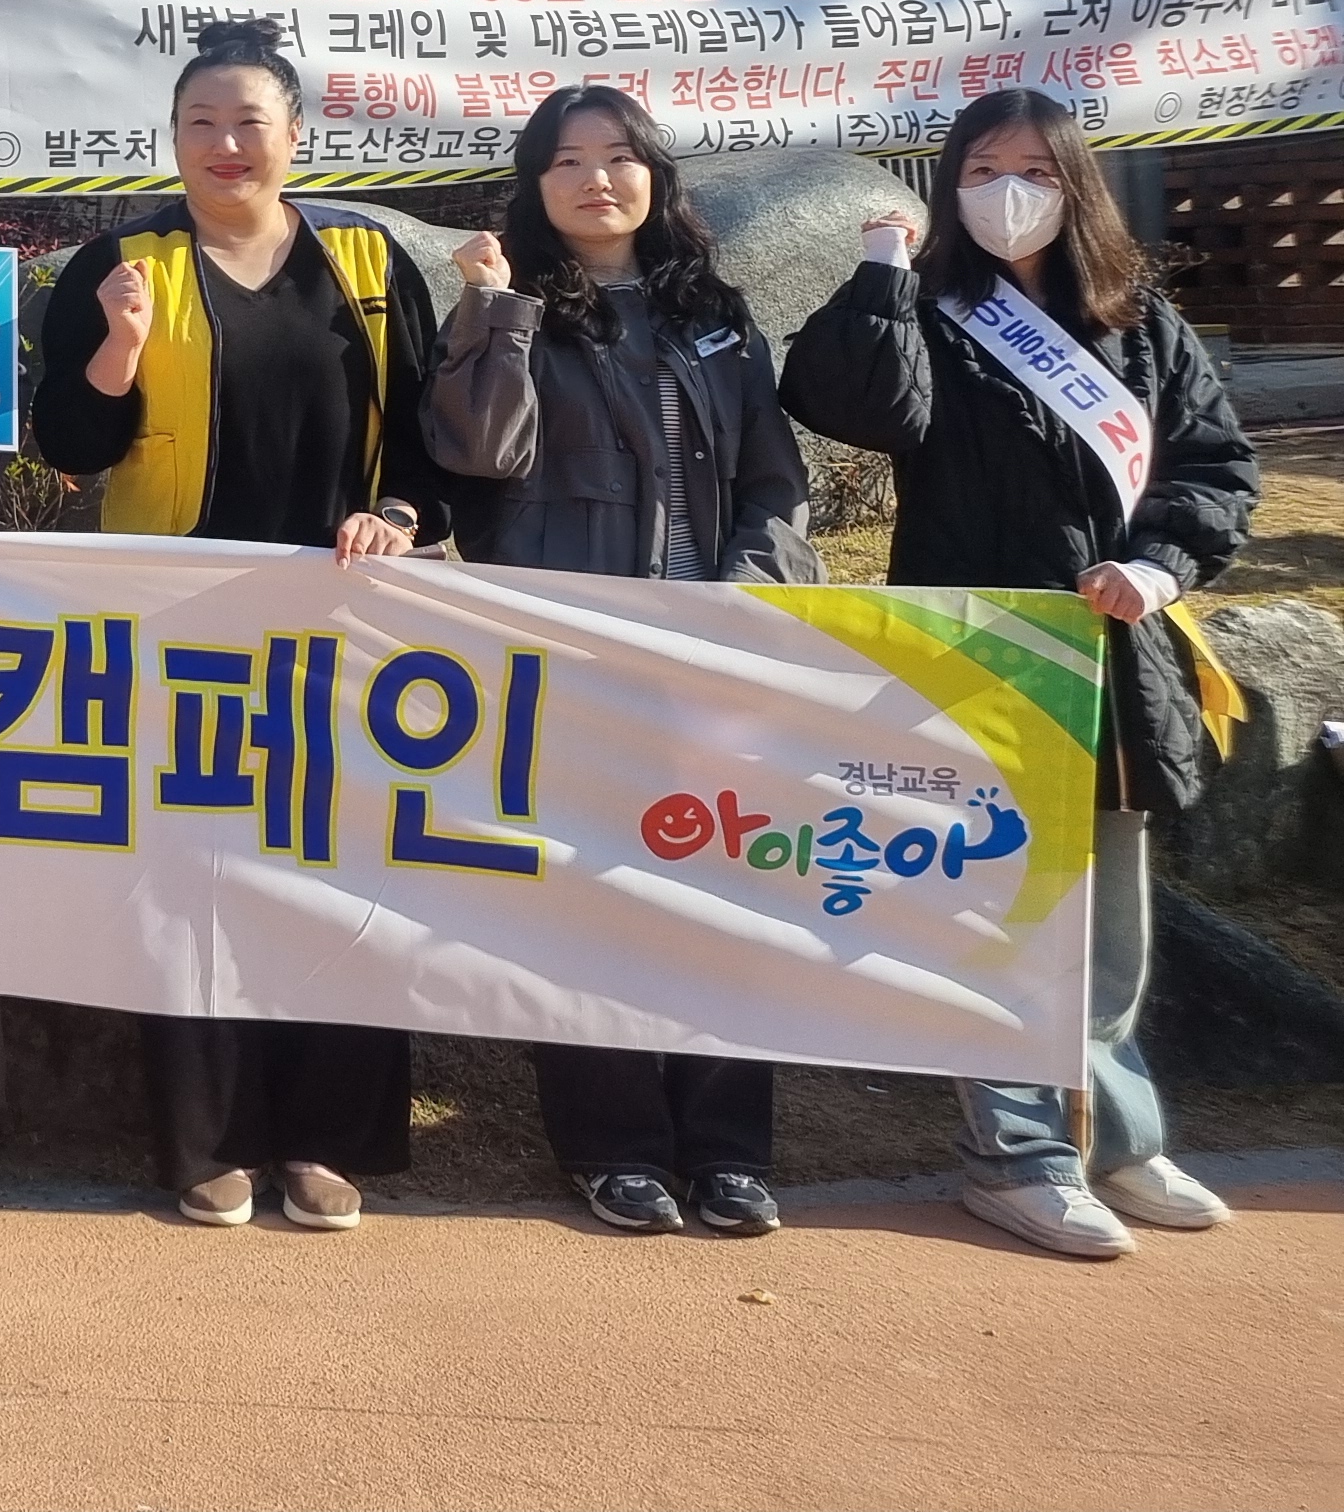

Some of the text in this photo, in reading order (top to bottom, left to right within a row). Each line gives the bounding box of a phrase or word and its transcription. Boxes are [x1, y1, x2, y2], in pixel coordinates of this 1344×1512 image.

[328, 8, 447, 59] 크레인
[470, 9, 508, 59] 및
[530, 5, 805, 59] 대형트레일러가
[322, 72, 437, 119] 통행에
[672, 62, 855, 112] 죄송합니다.
[874, 56, 943, 103] 주민
[958, 51, 1025, 98] 불편
[1041, 42, 1142, 90] 사항을
[1157, 33, 1260, 80] 최소화
[45, 128, 158, 168] 발주처
[694, 118, 793, 153] 시공사
[1198, 77, 1312, 119] 현장소장
[970, 296, 1109, 411] 아동학대
[1097, 409, 1144, 489] NO
[839, 761, 960, 799] 경남교육
[641, 790, 1028, 916] 아이좋아
